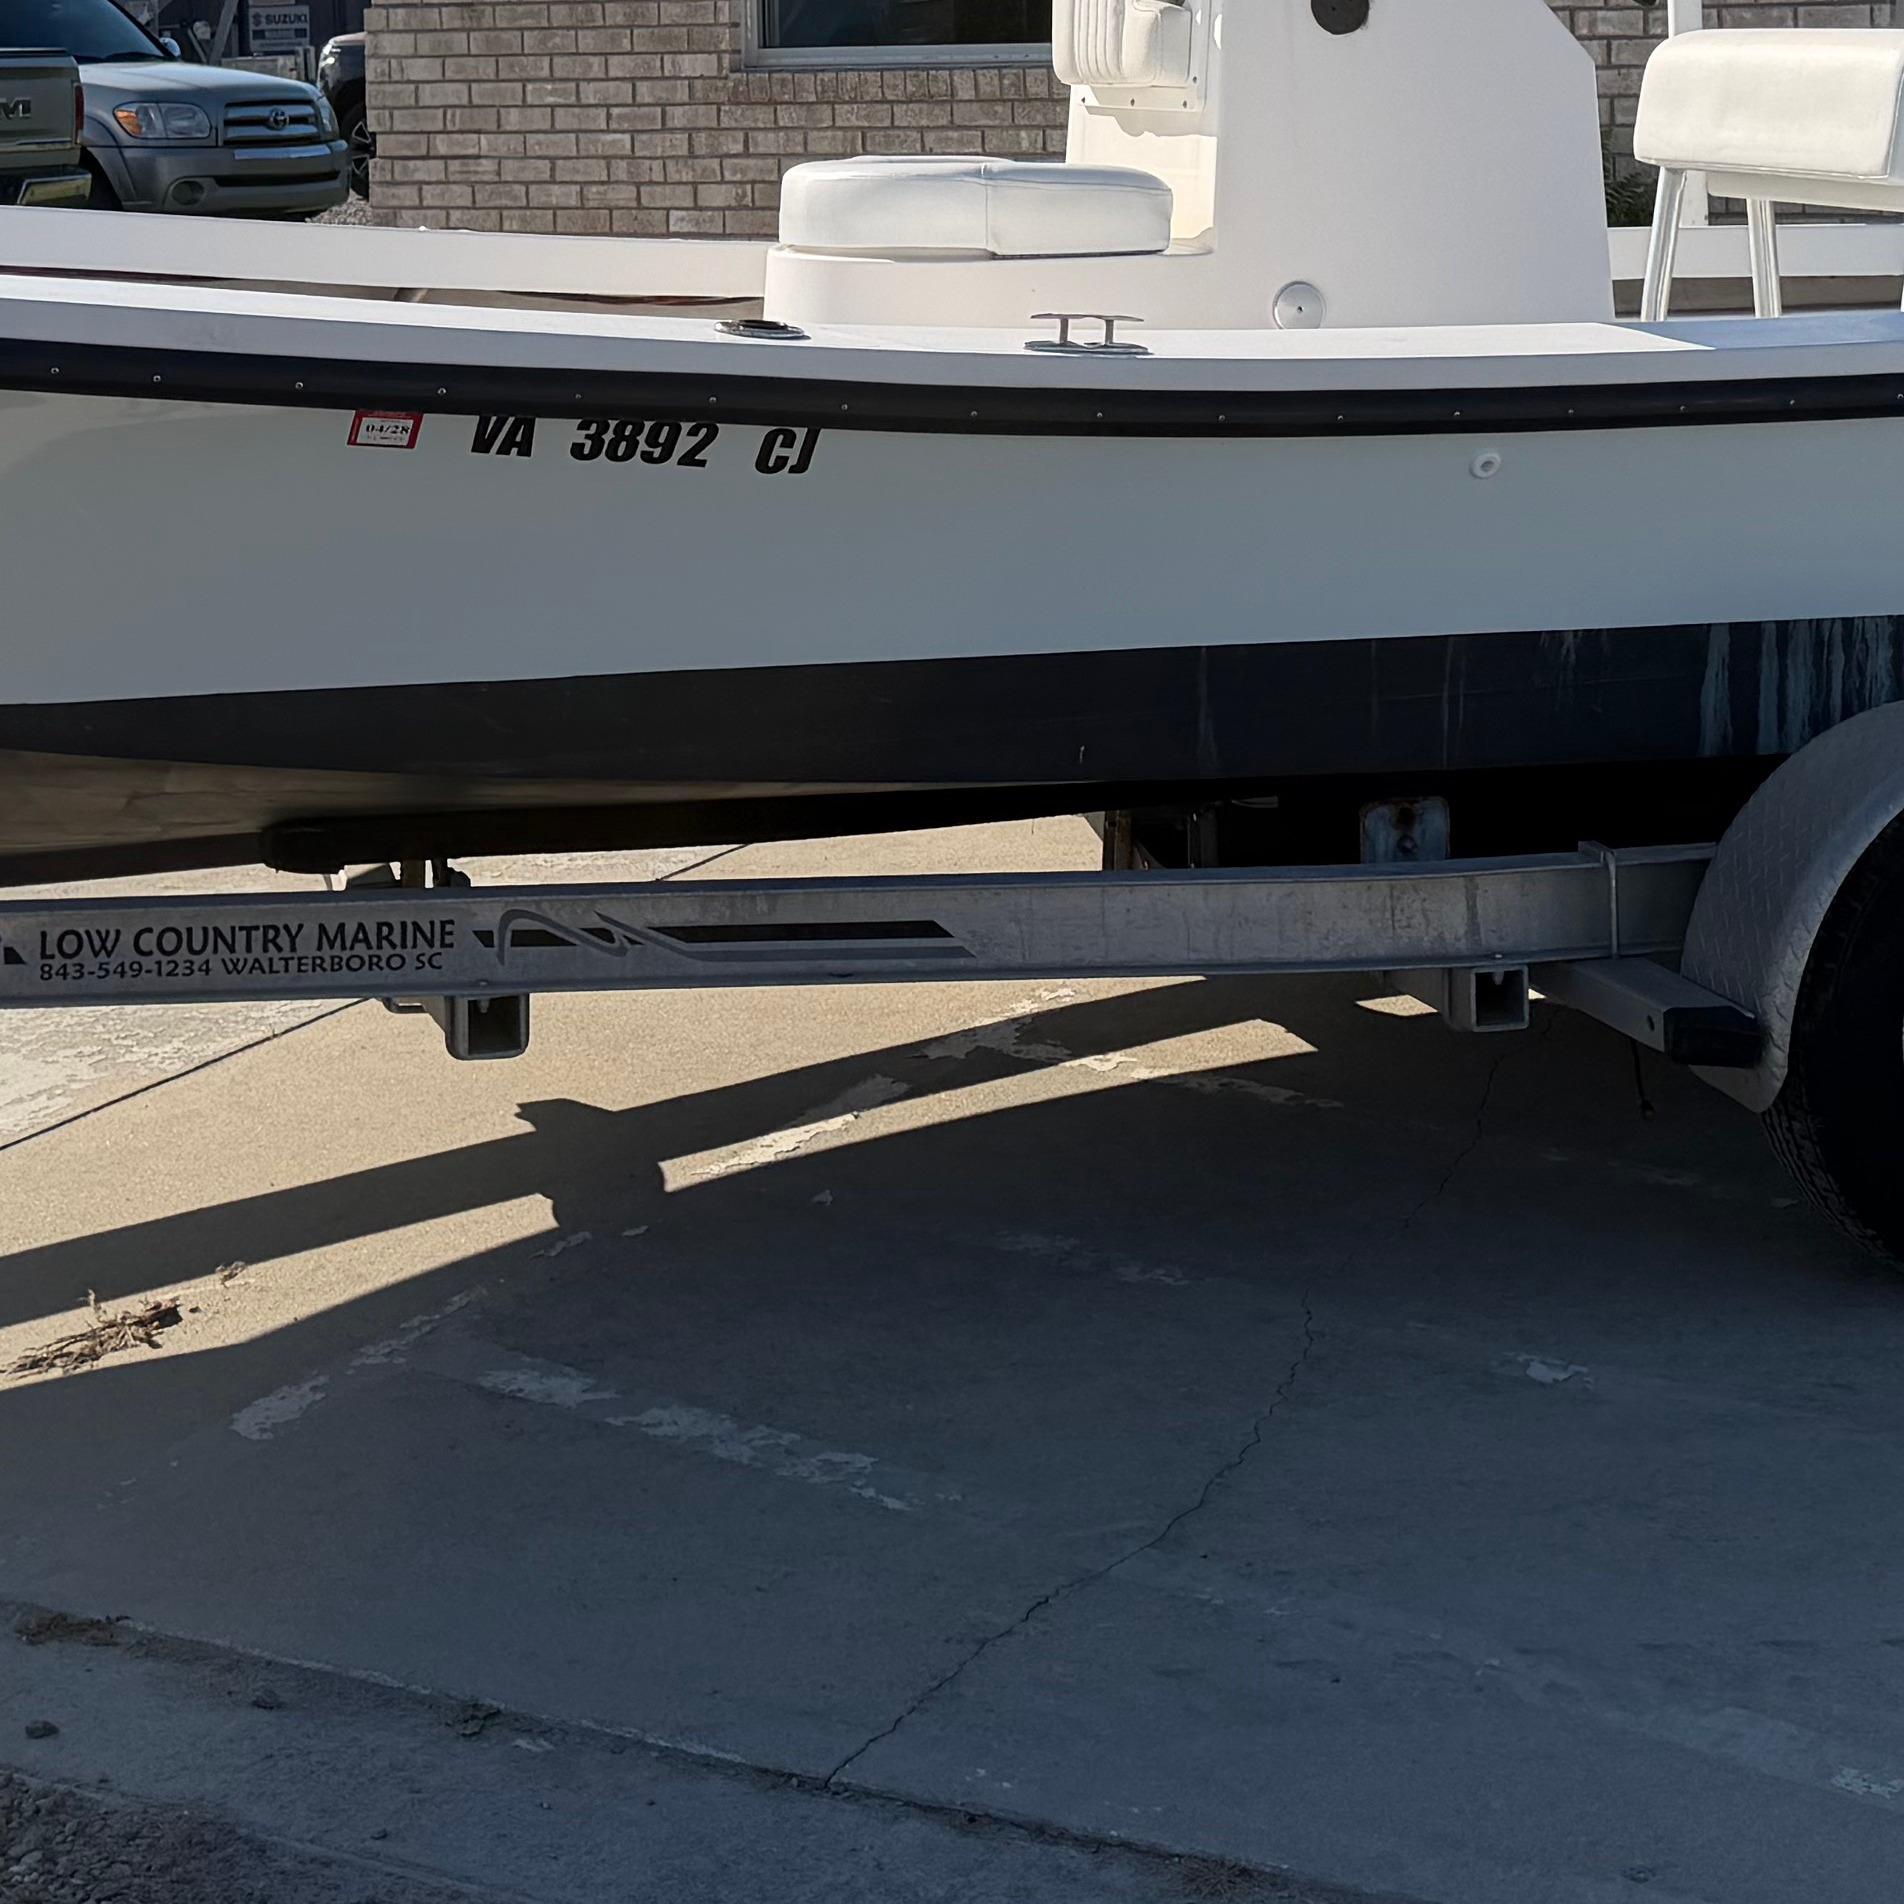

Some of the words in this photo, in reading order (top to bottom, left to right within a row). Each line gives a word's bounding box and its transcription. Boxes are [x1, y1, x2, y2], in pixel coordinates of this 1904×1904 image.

[265, 14, 308, 25] SUZUKI
[471, 415, 536, 458] VA
[570, 419, 720, 468] 3892
[755, 427, 821, 475] CJ
[39, 929, 121, 961] LOW
[133, 923, 304, 956] COUNTRY
[317, 919, 455, 952] MARINE
[39, 958, 211, 981] 843-549-1234
[221, 954, 406, 976] WALTERBORO
[415, 952, 443, 971] SC
